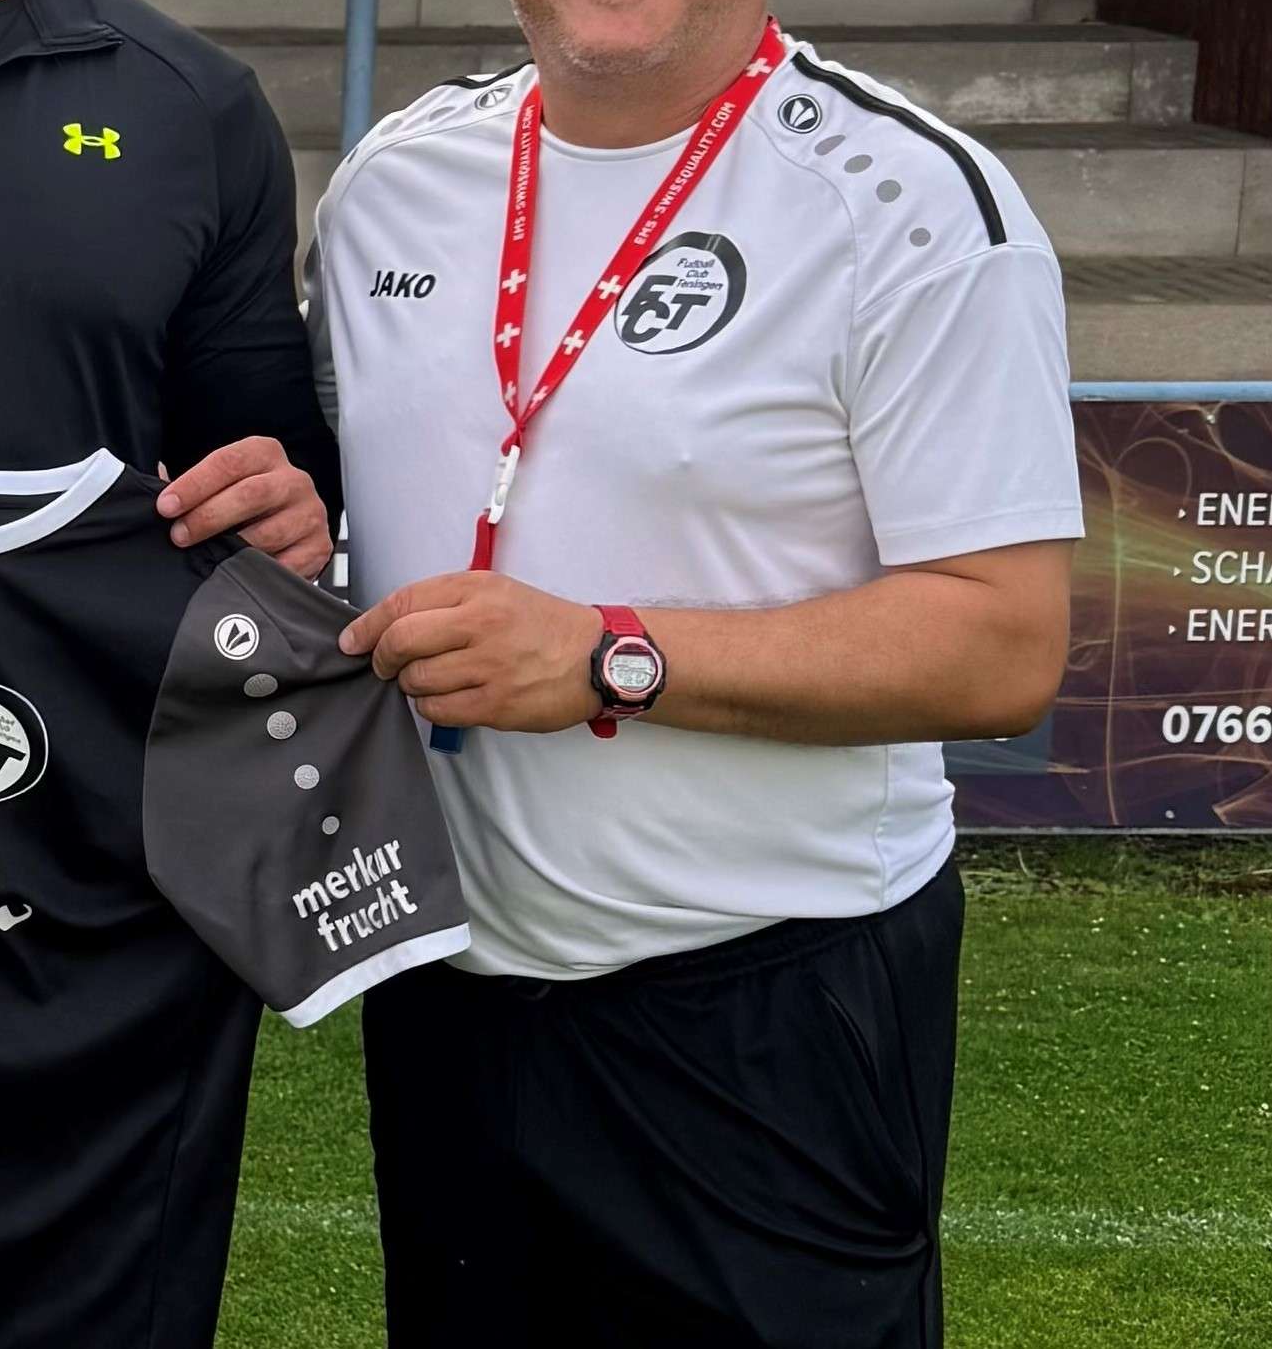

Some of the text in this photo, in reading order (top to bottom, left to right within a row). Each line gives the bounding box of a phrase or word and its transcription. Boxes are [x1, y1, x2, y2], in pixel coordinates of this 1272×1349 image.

[369, 270, 436, 299] JAKO
[1197, 492, 1272, 526] ENE
[1162, 705, 1272, 744] 0766
[317, 879, 418, 952] frucht
